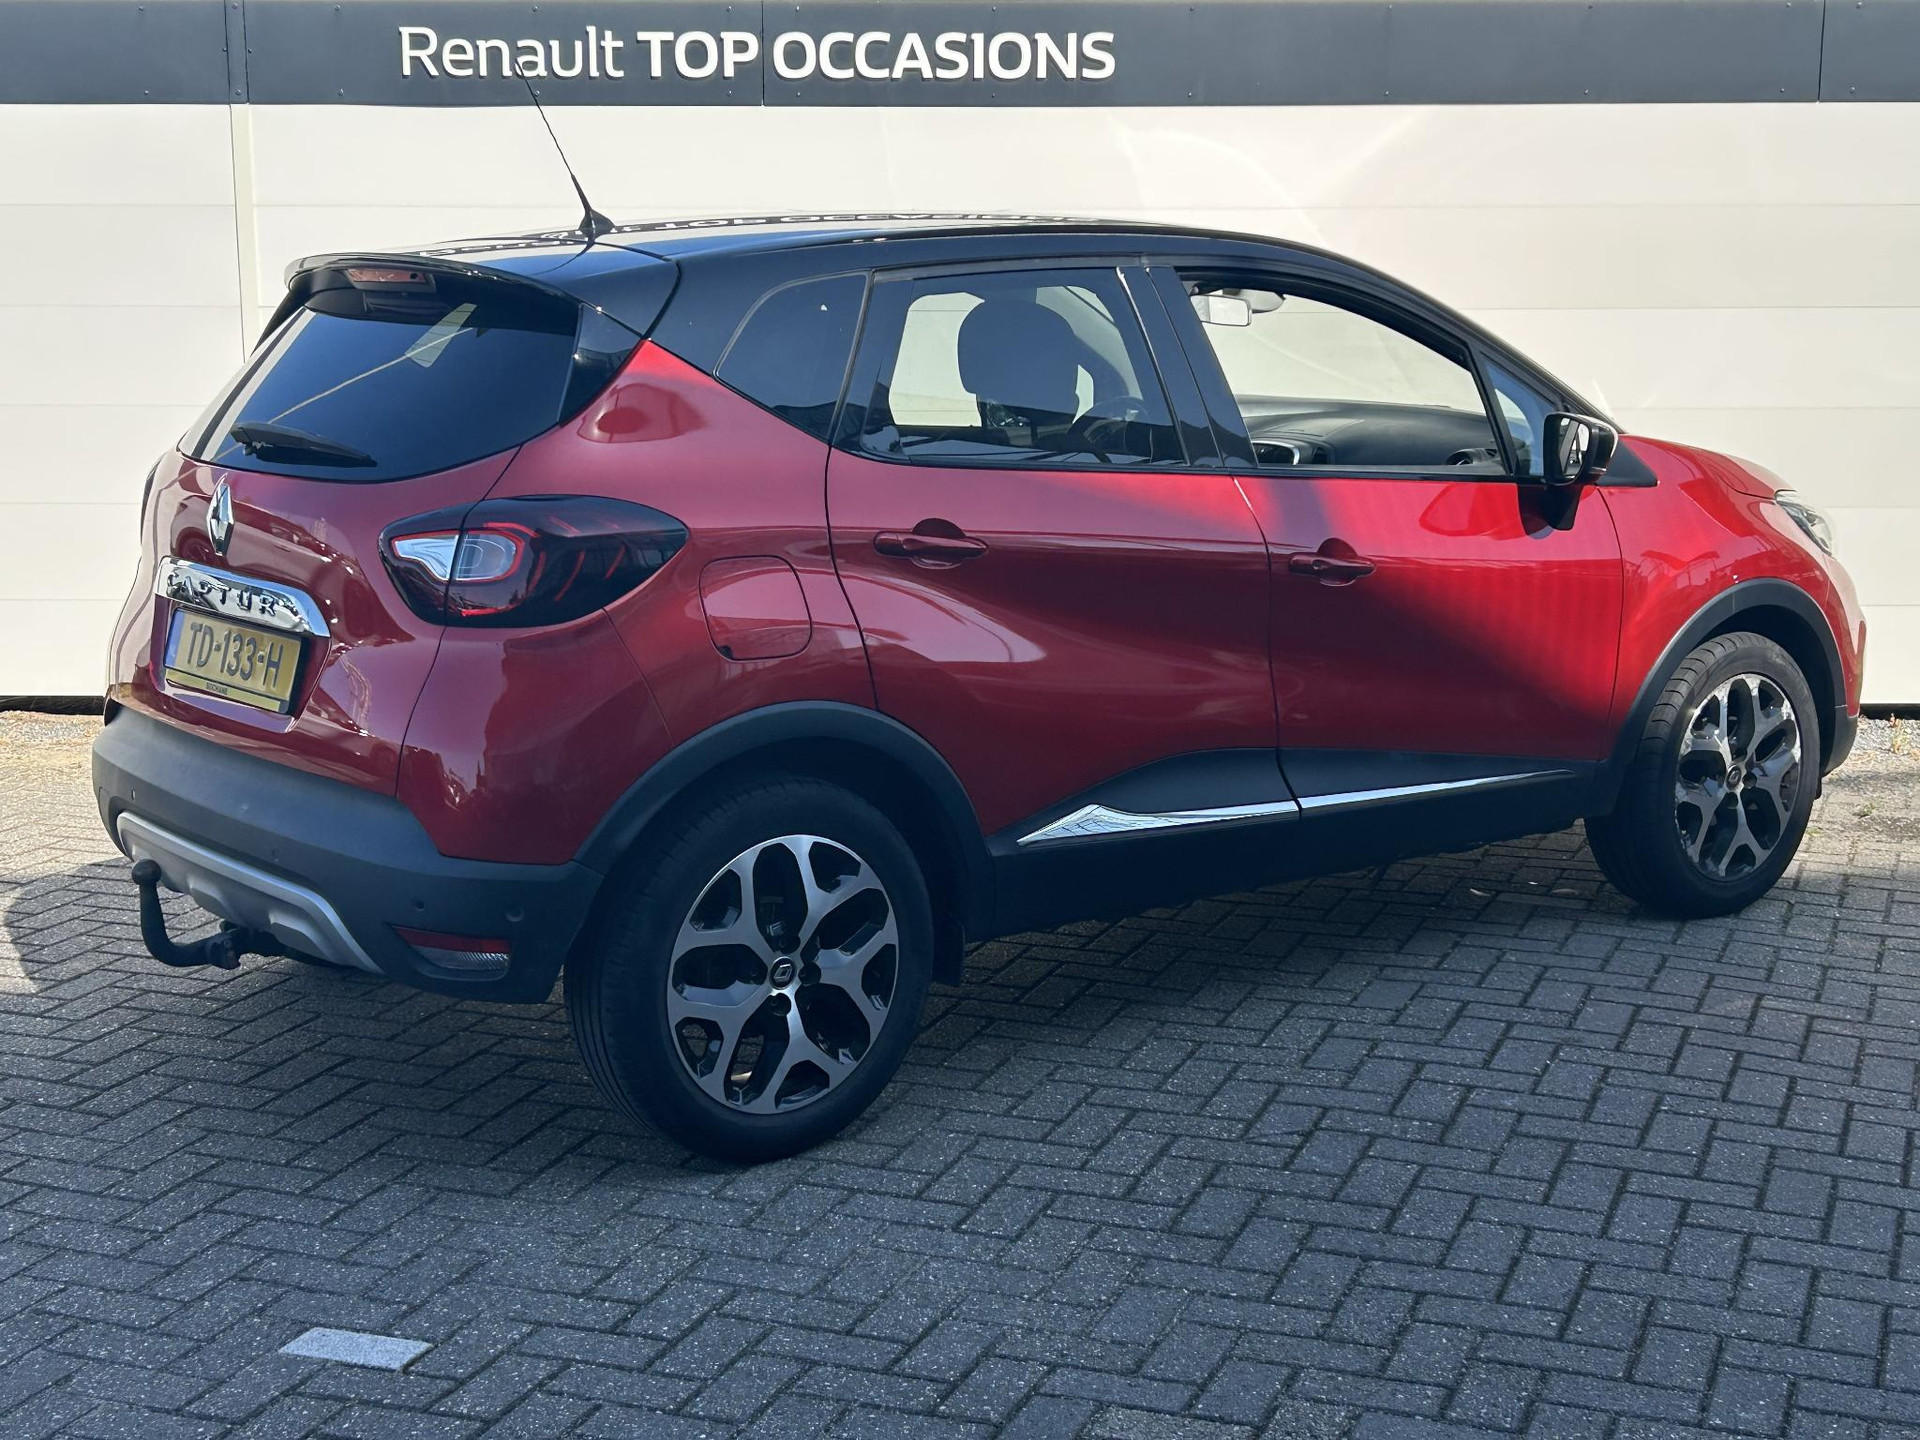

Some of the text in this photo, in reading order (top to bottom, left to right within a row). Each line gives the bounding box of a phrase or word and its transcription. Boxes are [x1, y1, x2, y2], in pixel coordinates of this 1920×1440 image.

[398, 25, 1117, 80] Renault TOP OCCASIONS
[187, 622, 284, 689] TD-133-H
